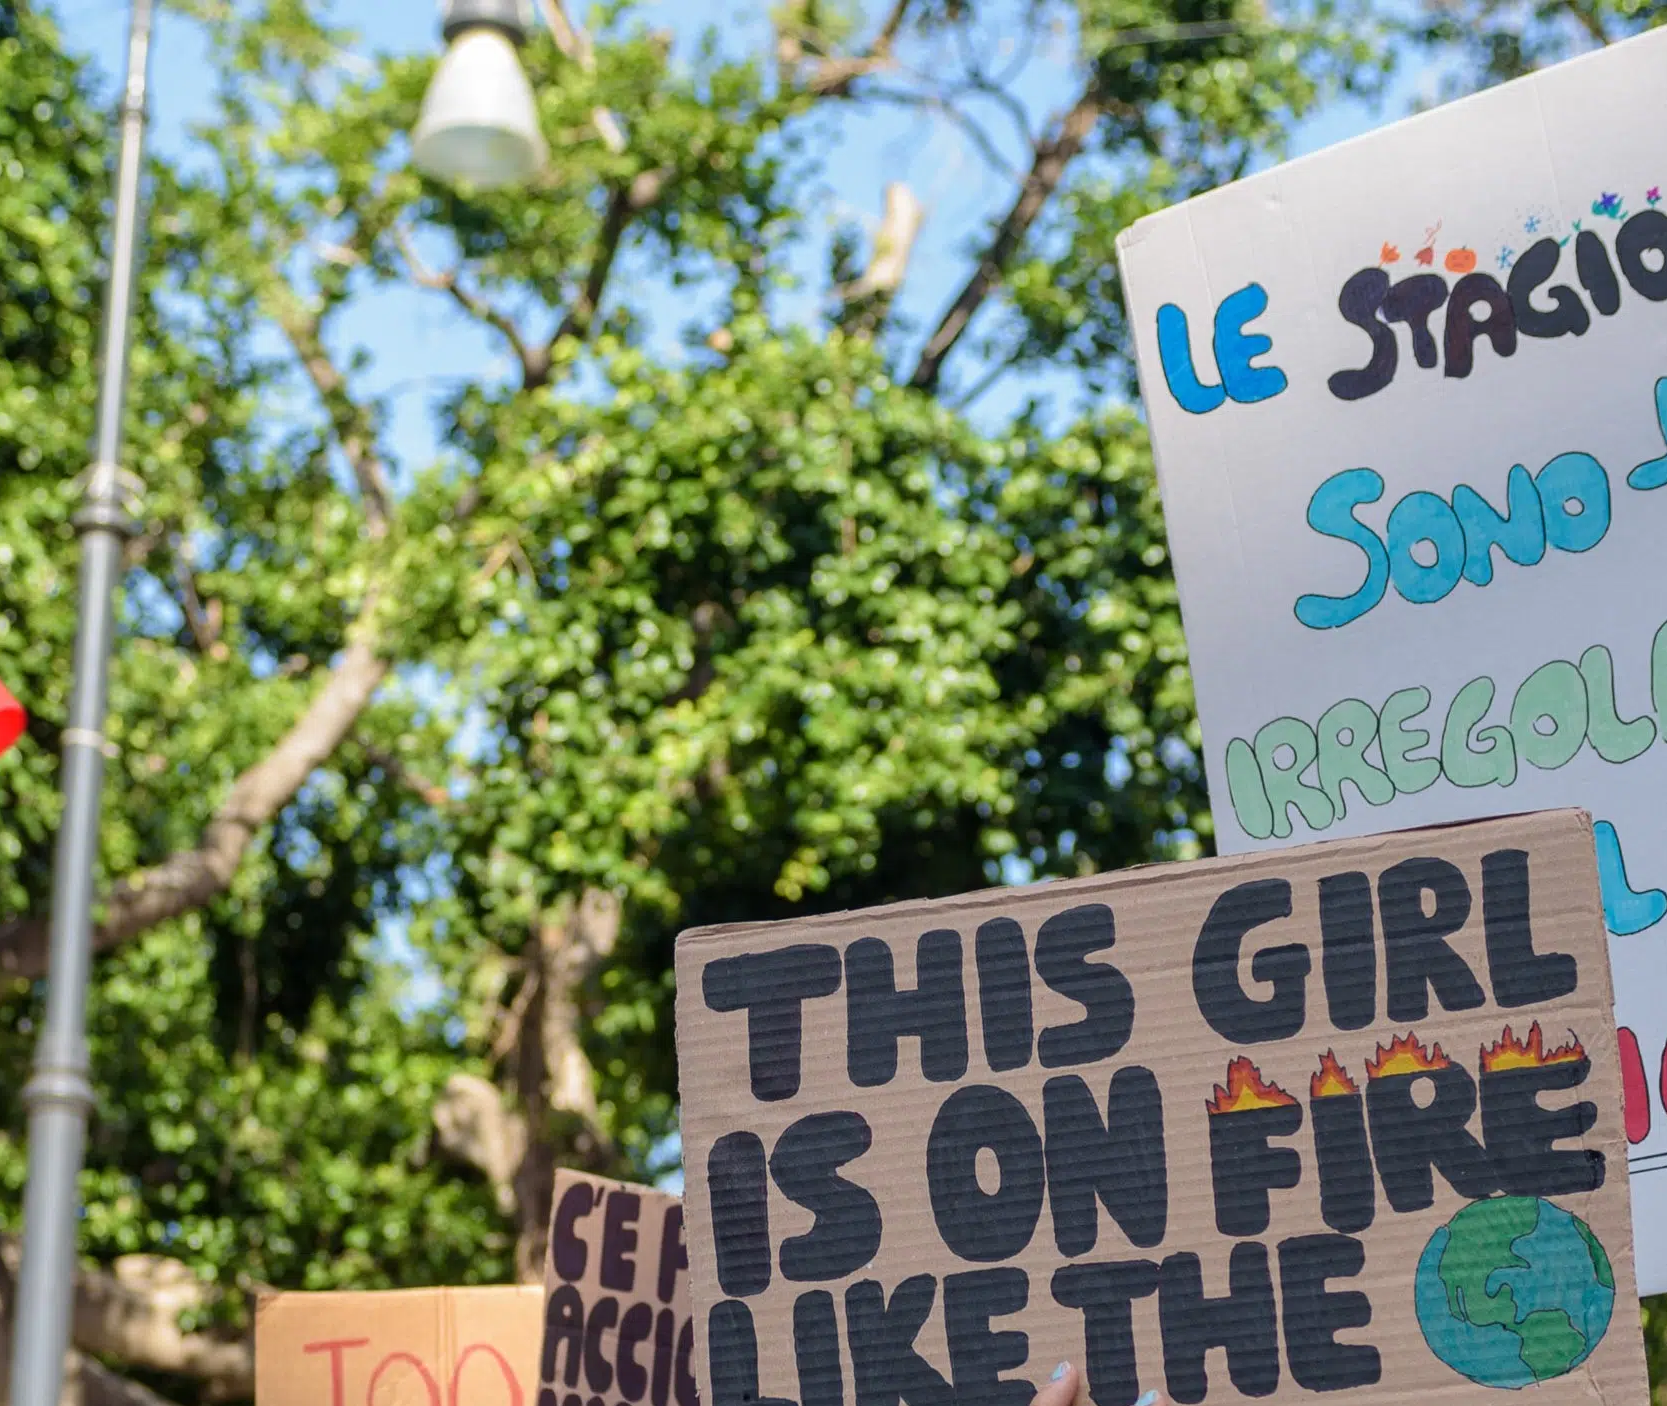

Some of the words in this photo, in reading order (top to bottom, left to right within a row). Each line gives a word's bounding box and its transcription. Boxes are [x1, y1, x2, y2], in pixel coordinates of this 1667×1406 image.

[1157, 282, 1288, 414] LE
[1294, 451, 1611, 630] SONO
[702, 903, 1135, 1102] THIS
[1193, 849, 1578, 1044] GIRL
[707, 1111, 883, 1297] IS
[926, 1065, 1168, 1262] ON
[1207, 1048, 1606, 1236] FIRE
